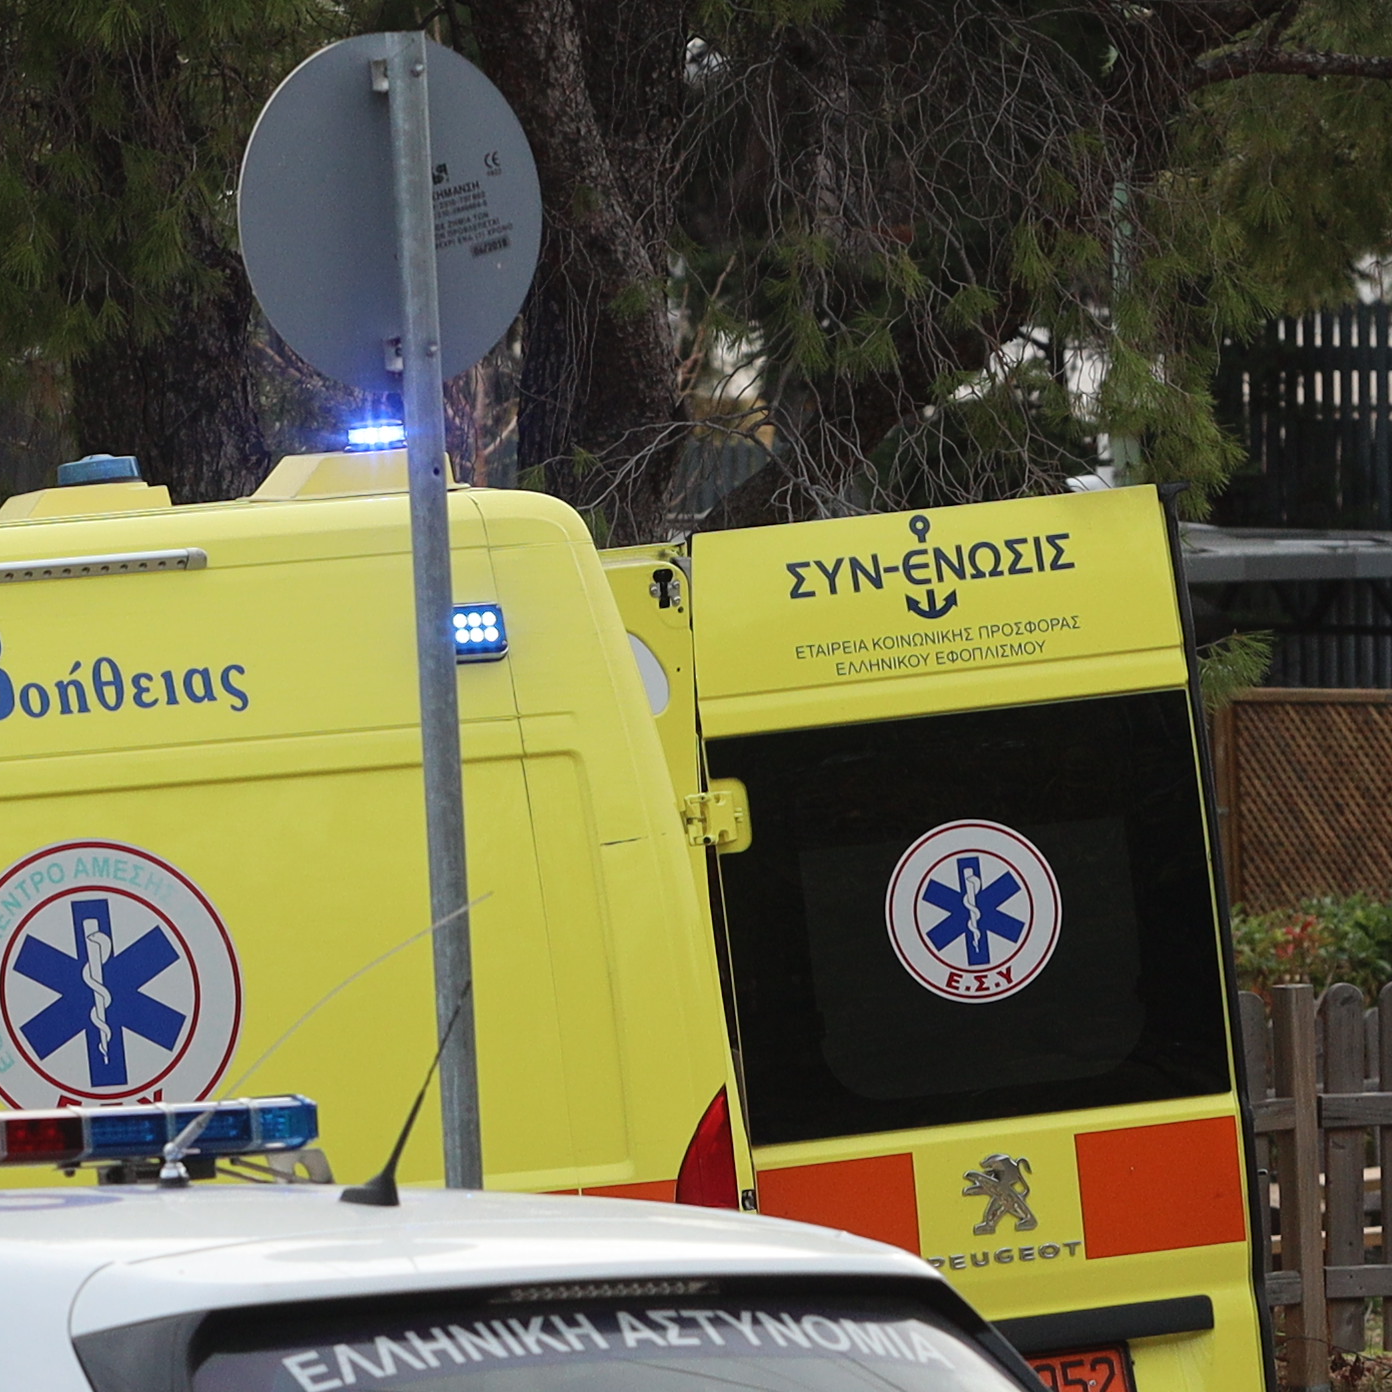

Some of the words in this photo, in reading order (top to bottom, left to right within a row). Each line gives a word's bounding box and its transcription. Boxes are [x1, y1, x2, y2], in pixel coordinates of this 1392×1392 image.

[795, 638, 869, 660] ΕΤΑΙΡΕΙΑ
[871, 627, 974, 651] ΚΟΙΝΩΝΙΚΗΣ
[978, 615, 1082, 640] ΠΡΟΣΦΟΡΑΣ
[835, 653, 931, 677] ΕΛΛΗΝΙΚΟΥ
[935, 639, 1047, 666] ΕΦΟΠΛΙΣΜΟΥ
[617, 1309, 955, 1369] ΑΣΤΥΝΟΜΙΑ
